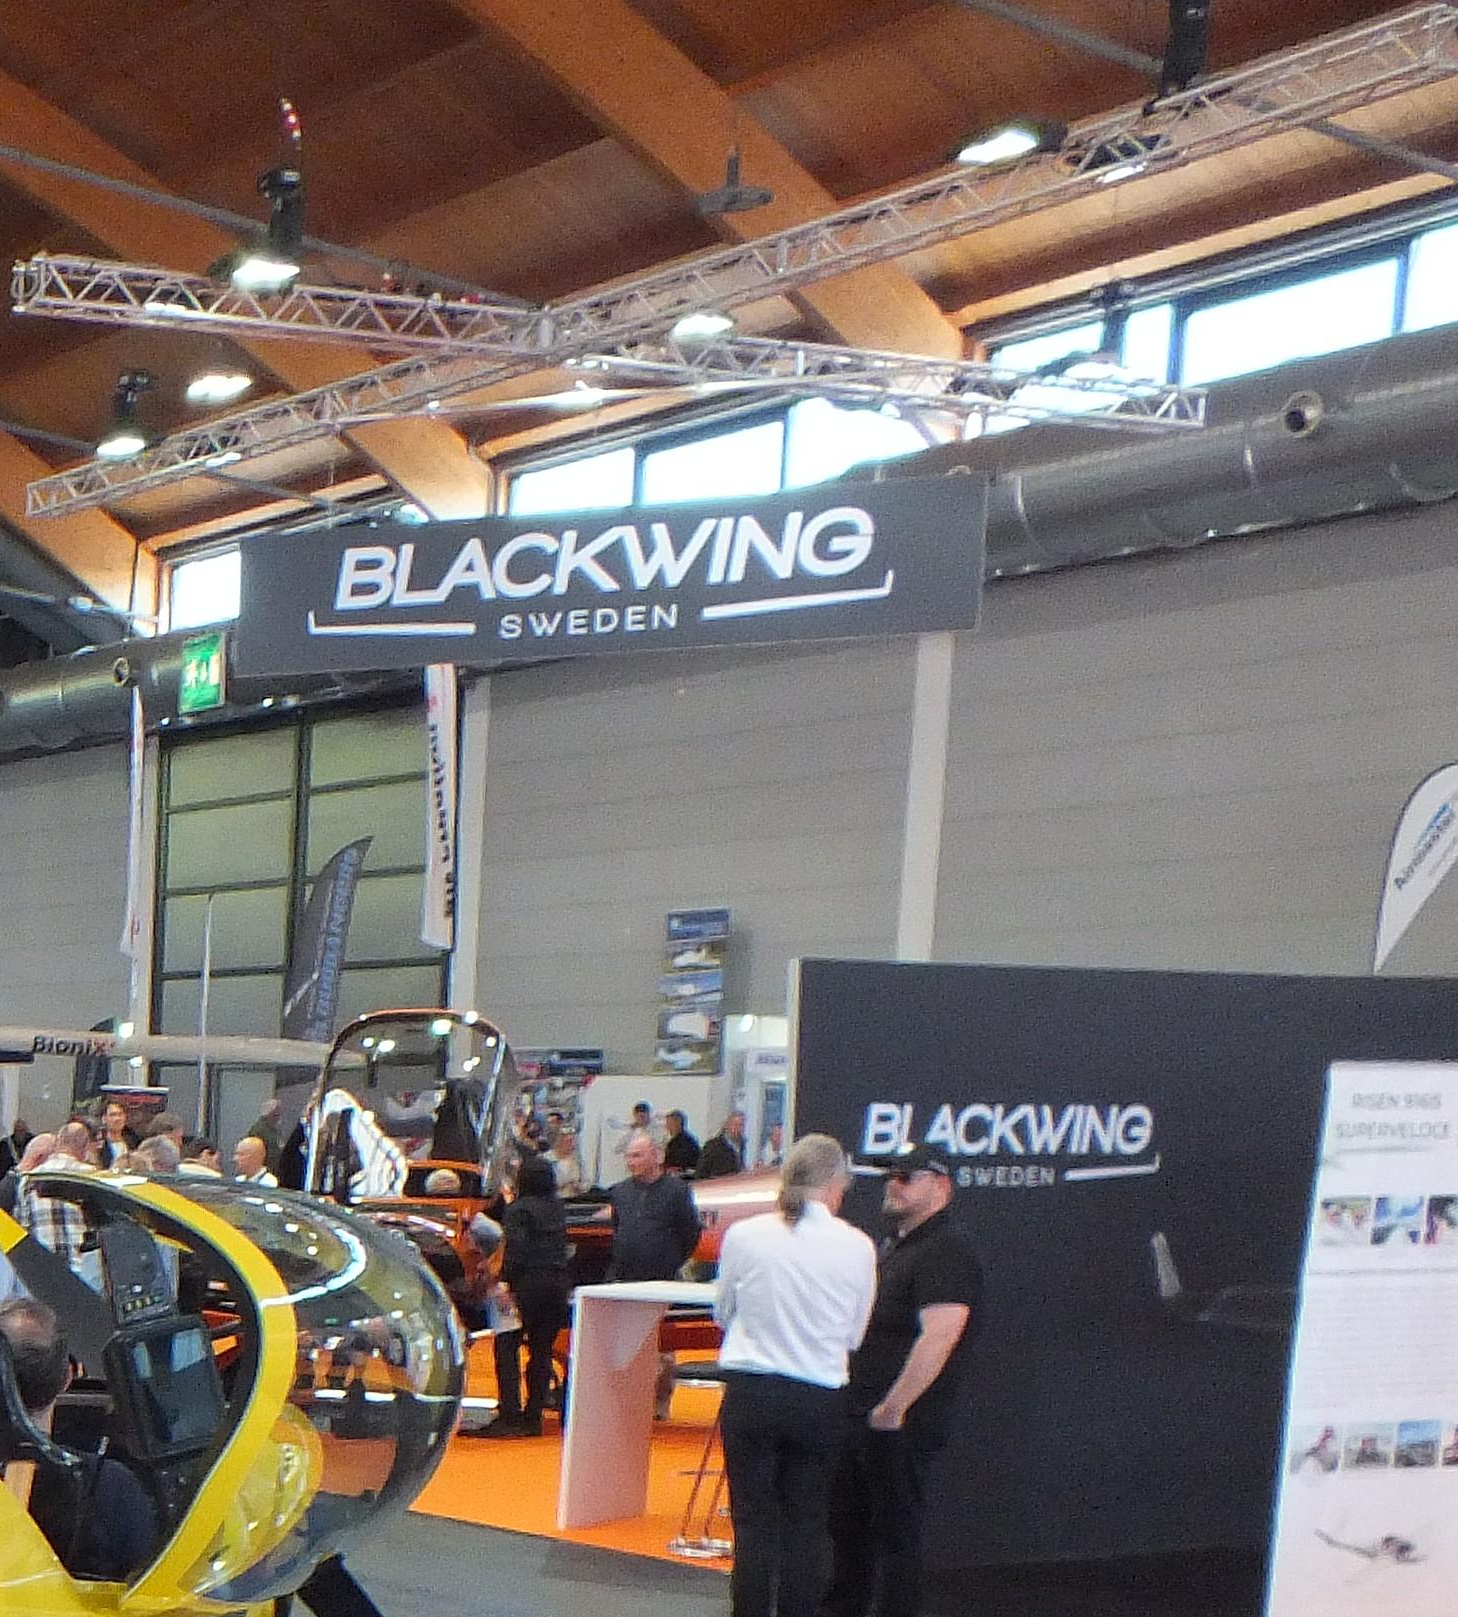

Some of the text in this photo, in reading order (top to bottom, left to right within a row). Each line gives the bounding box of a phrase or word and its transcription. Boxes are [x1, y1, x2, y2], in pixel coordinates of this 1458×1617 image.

[334, 507, 875, 610] BLACKWING
[499, 604, 678, 639] SWEDEN
[863, 1102, 1154, 1155] BLACKWING
[956, 1164, 1056, 1188] SWEDEN
